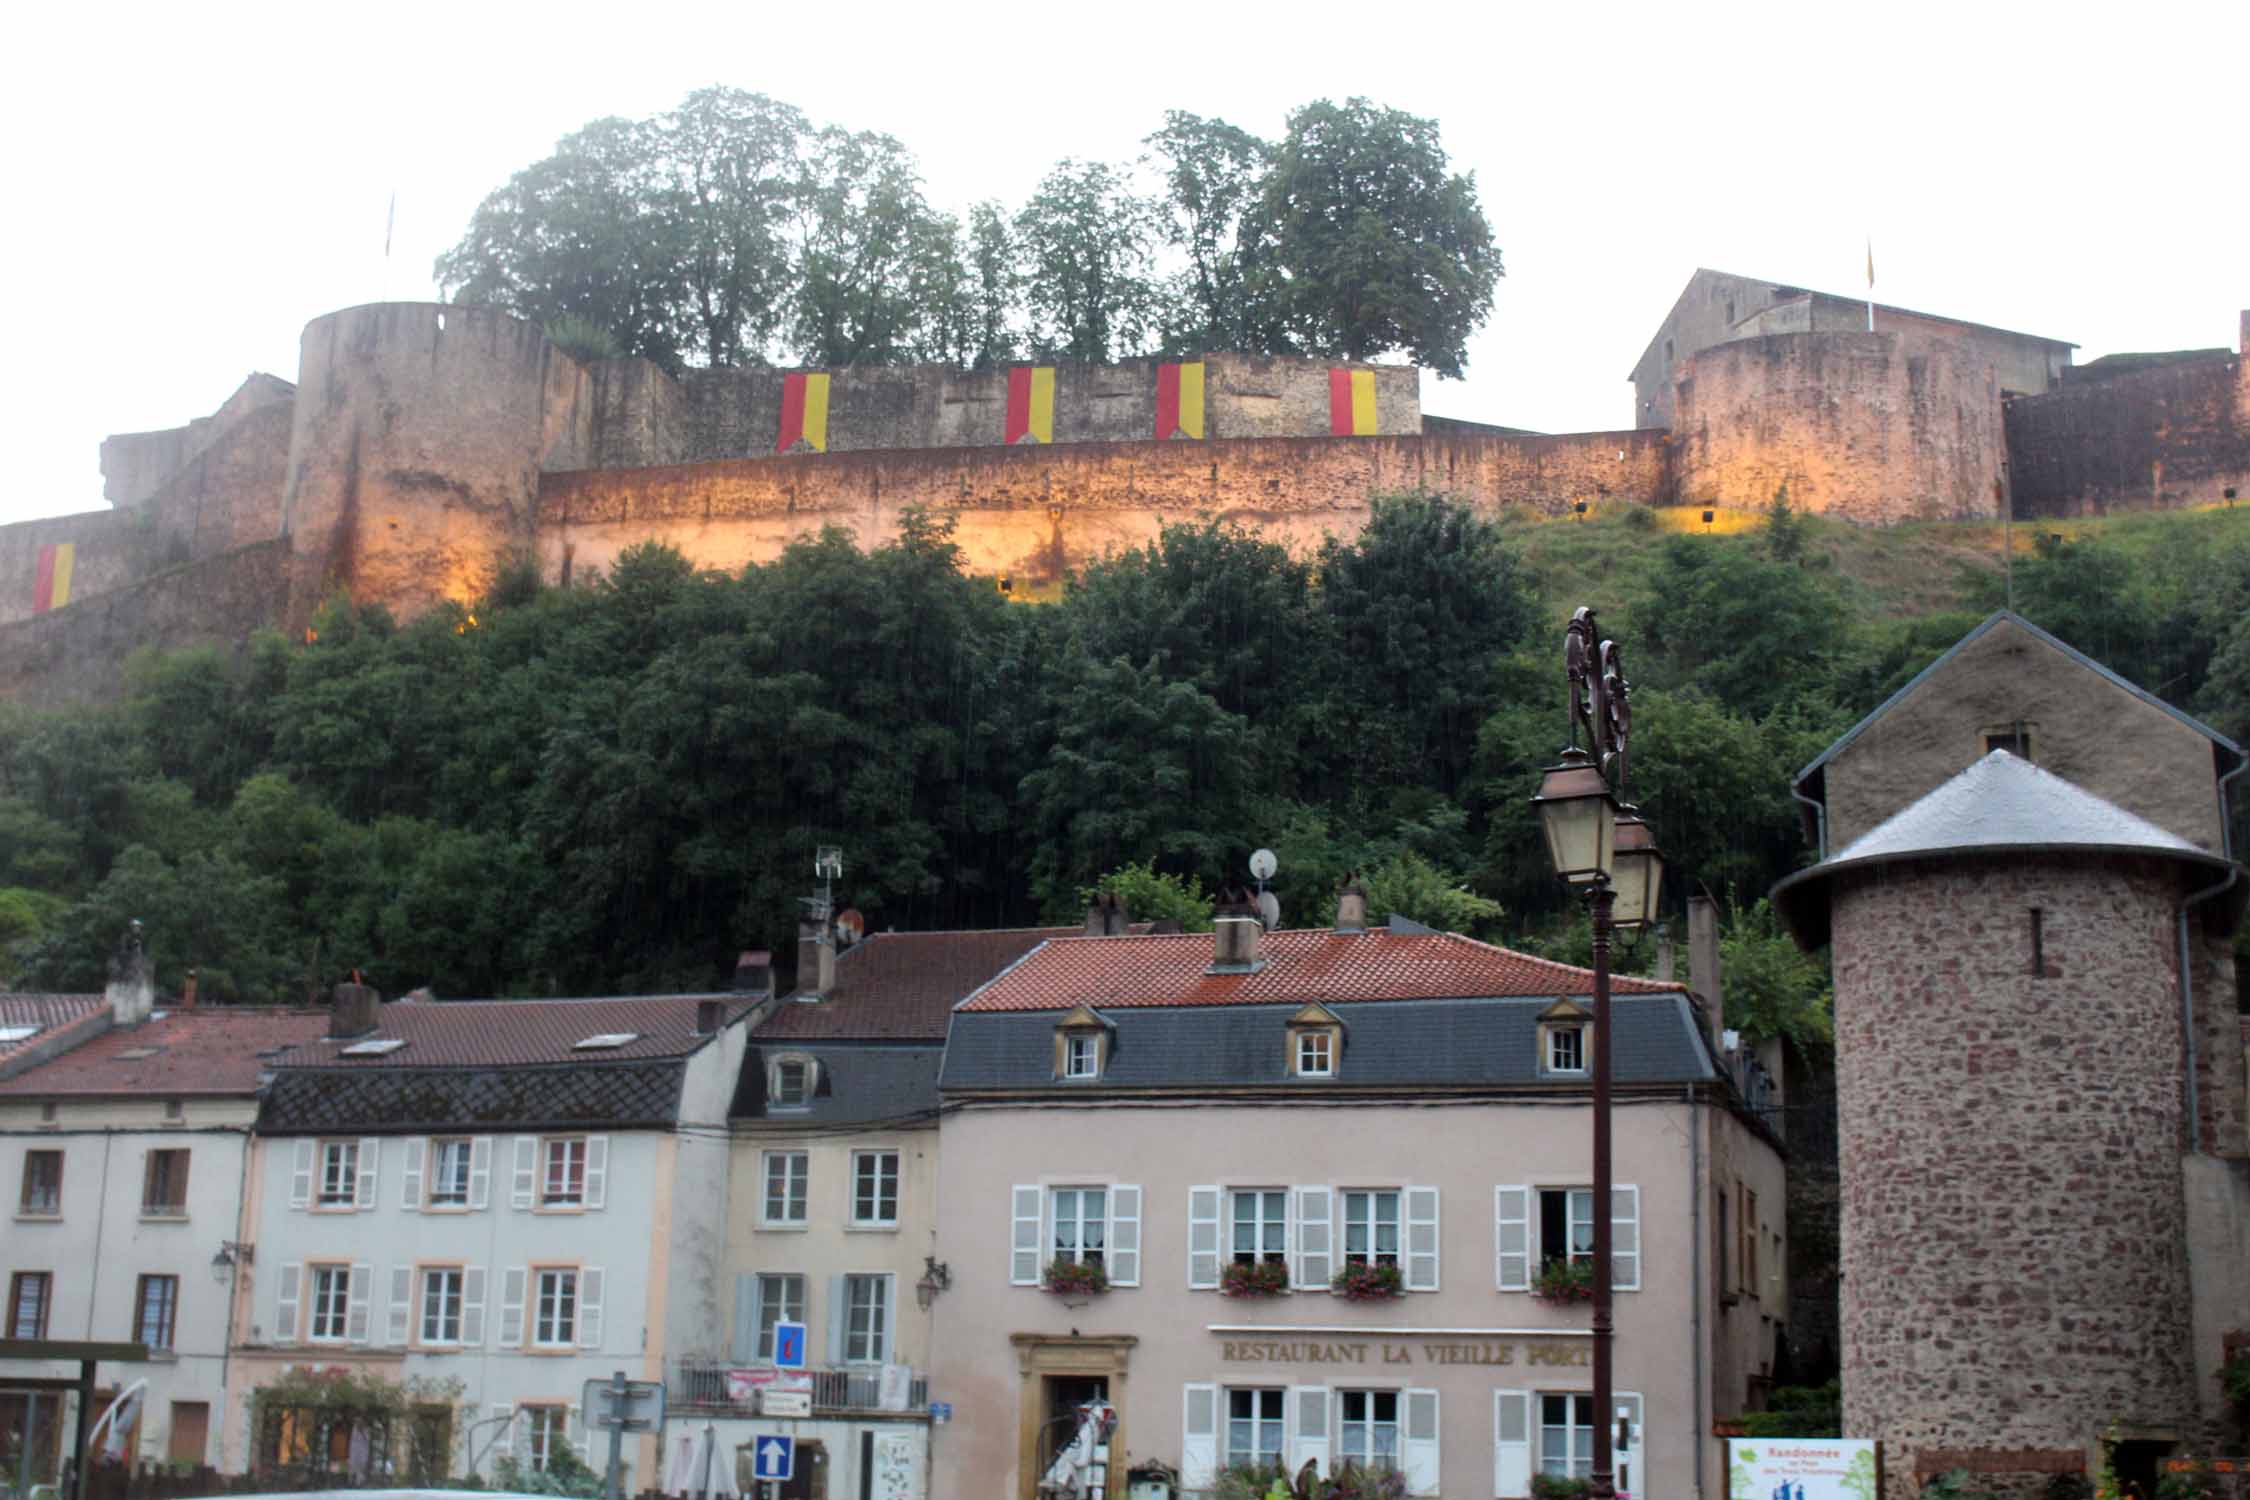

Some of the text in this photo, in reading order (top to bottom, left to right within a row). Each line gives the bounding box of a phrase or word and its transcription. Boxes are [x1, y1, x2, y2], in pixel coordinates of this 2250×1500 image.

[1222, 1342, 1593, 1367] RESTAURANT LA VIEILLE PORT
